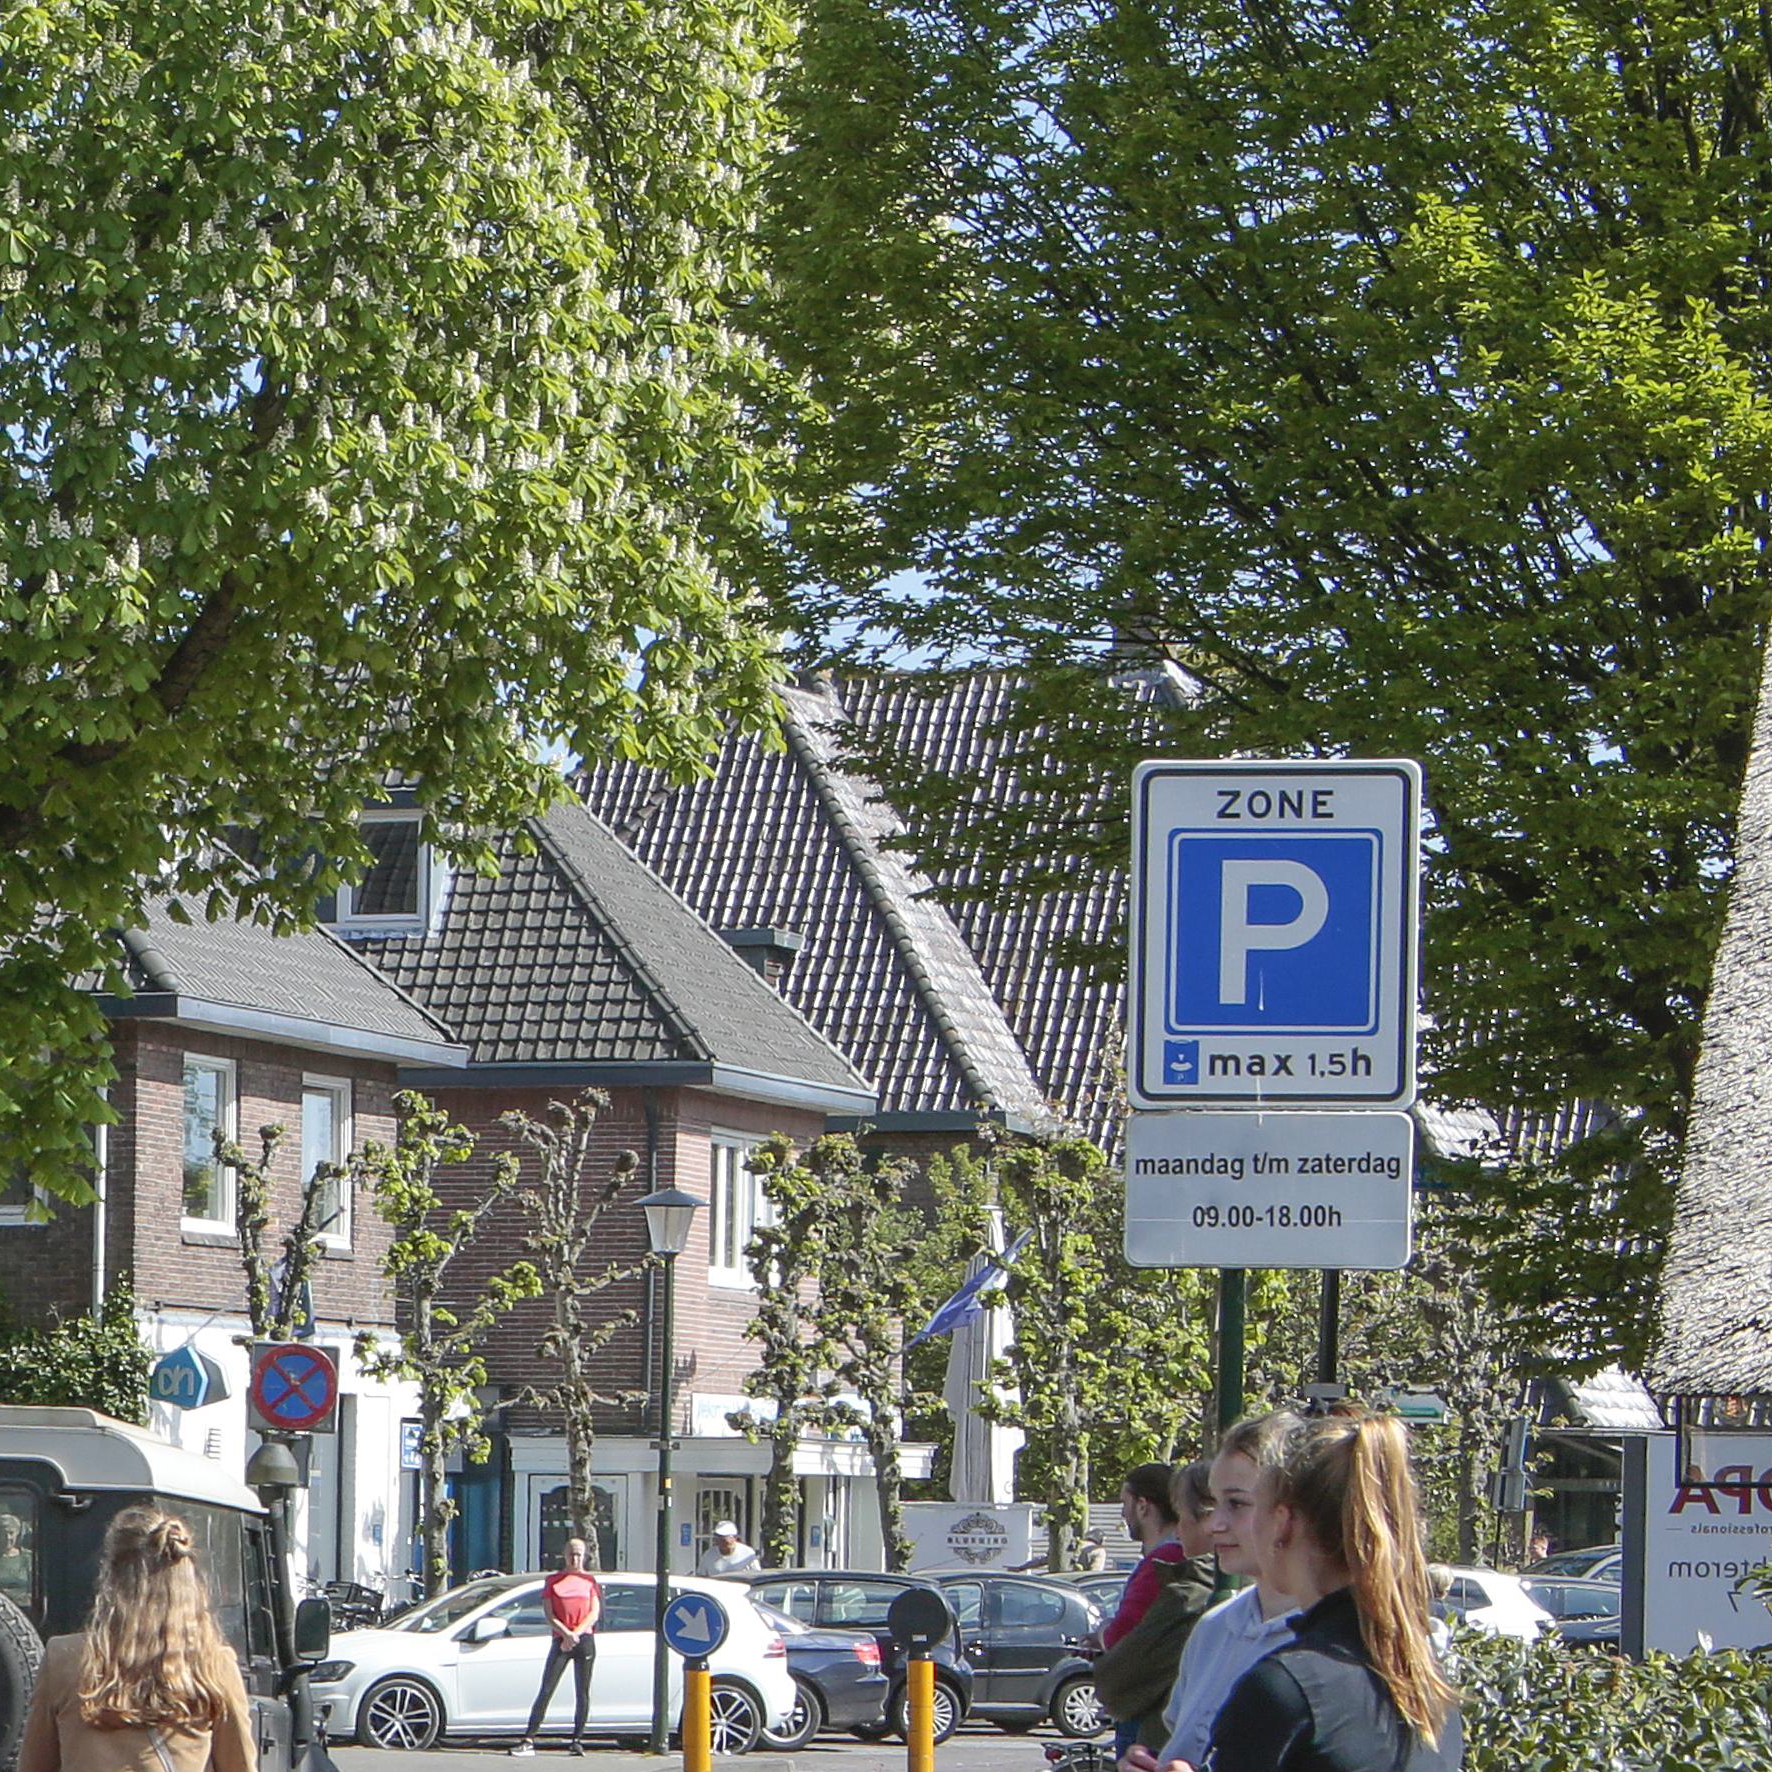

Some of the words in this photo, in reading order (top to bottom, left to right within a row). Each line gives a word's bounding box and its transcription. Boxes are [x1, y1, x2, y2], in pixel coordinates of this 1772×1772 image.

[1216, 789, 1335, 819] ZONE
[1218, 859, 1330, 1006] P
[1207, 1052, 1295, 1077] max
[1307, 1046, 1372, 1078] 1,5h
[1134, 1152, 1245, 1180] maandag
[1252, 1152, 1290, 1176] t/m
[1296, 1151, 1401, 1179] zaterdag
[1192, 1204, 1342, 1229] 09.00-18.00h
